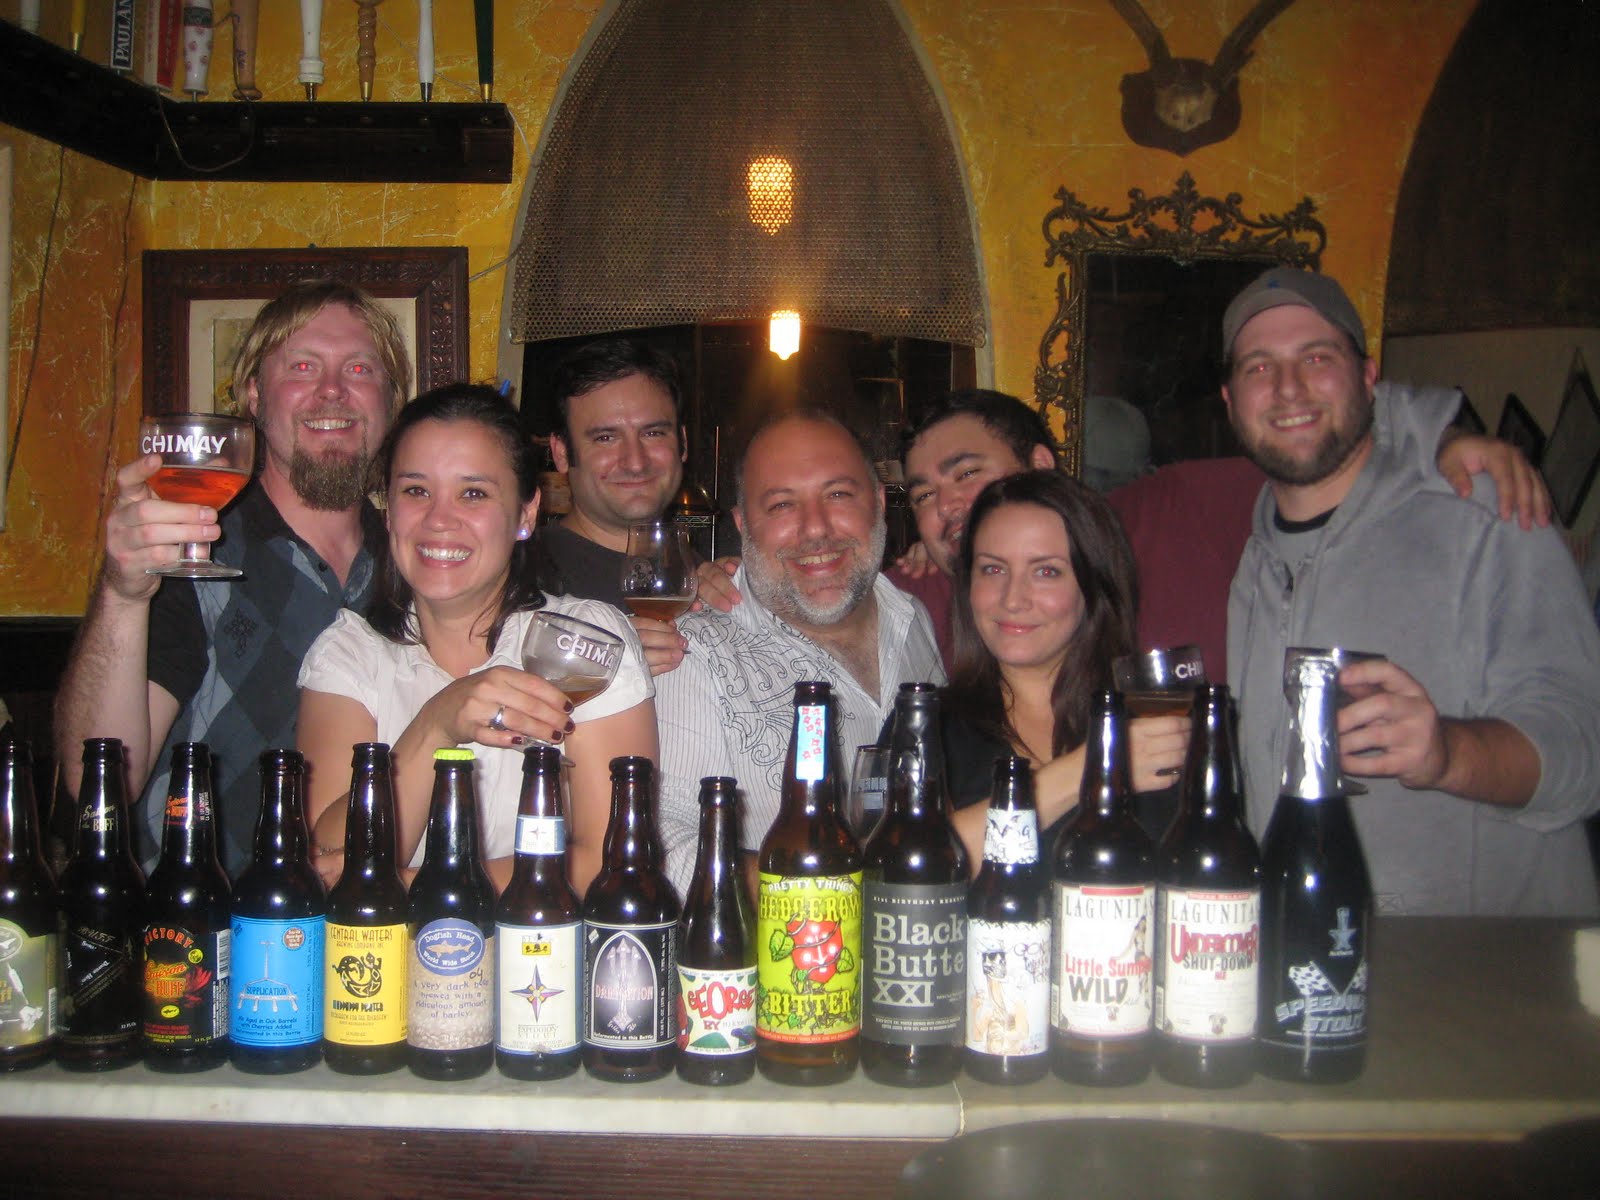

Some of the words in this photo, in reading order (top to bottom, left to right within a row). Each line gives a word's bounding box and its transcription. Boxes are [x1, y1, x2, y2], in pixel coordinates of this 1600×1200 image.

[141, 434, 227, 454] CHIMAY
[768, 880, 811, 893] PRETTY
[816, 879, 855, 893] THINGS
[760, 894, 861, 922] HEDGEROW
[144, 927, 194, 949] VICTORY
[330, 926, 359, 942] CENTRAL
[361, 929, 393, 942] WATERS
[425, 931, 452, 943] Dogfish
[456, 931, 475, 943] Head
[873, 912, 965, 946] Black
[442, 959, 458, 967] Wide
[873, 944, 964, 978] Butte
[1065, 953, 1104, 977] Little
[420, 981, 441, 991] very
[447, 980, 469, 991] dark
[872, 977, 935, 1008] XXI
[1069, 975, 1129, 1005] WILD
[415, 1000, 453, 1009] ridiculous
[458, 1000, 488, 1009] amount
[421, 992, 450, 1000] brewed
[767, 989, 850, 1016] BITTER
[703, 1019, 720, 1031] BY
